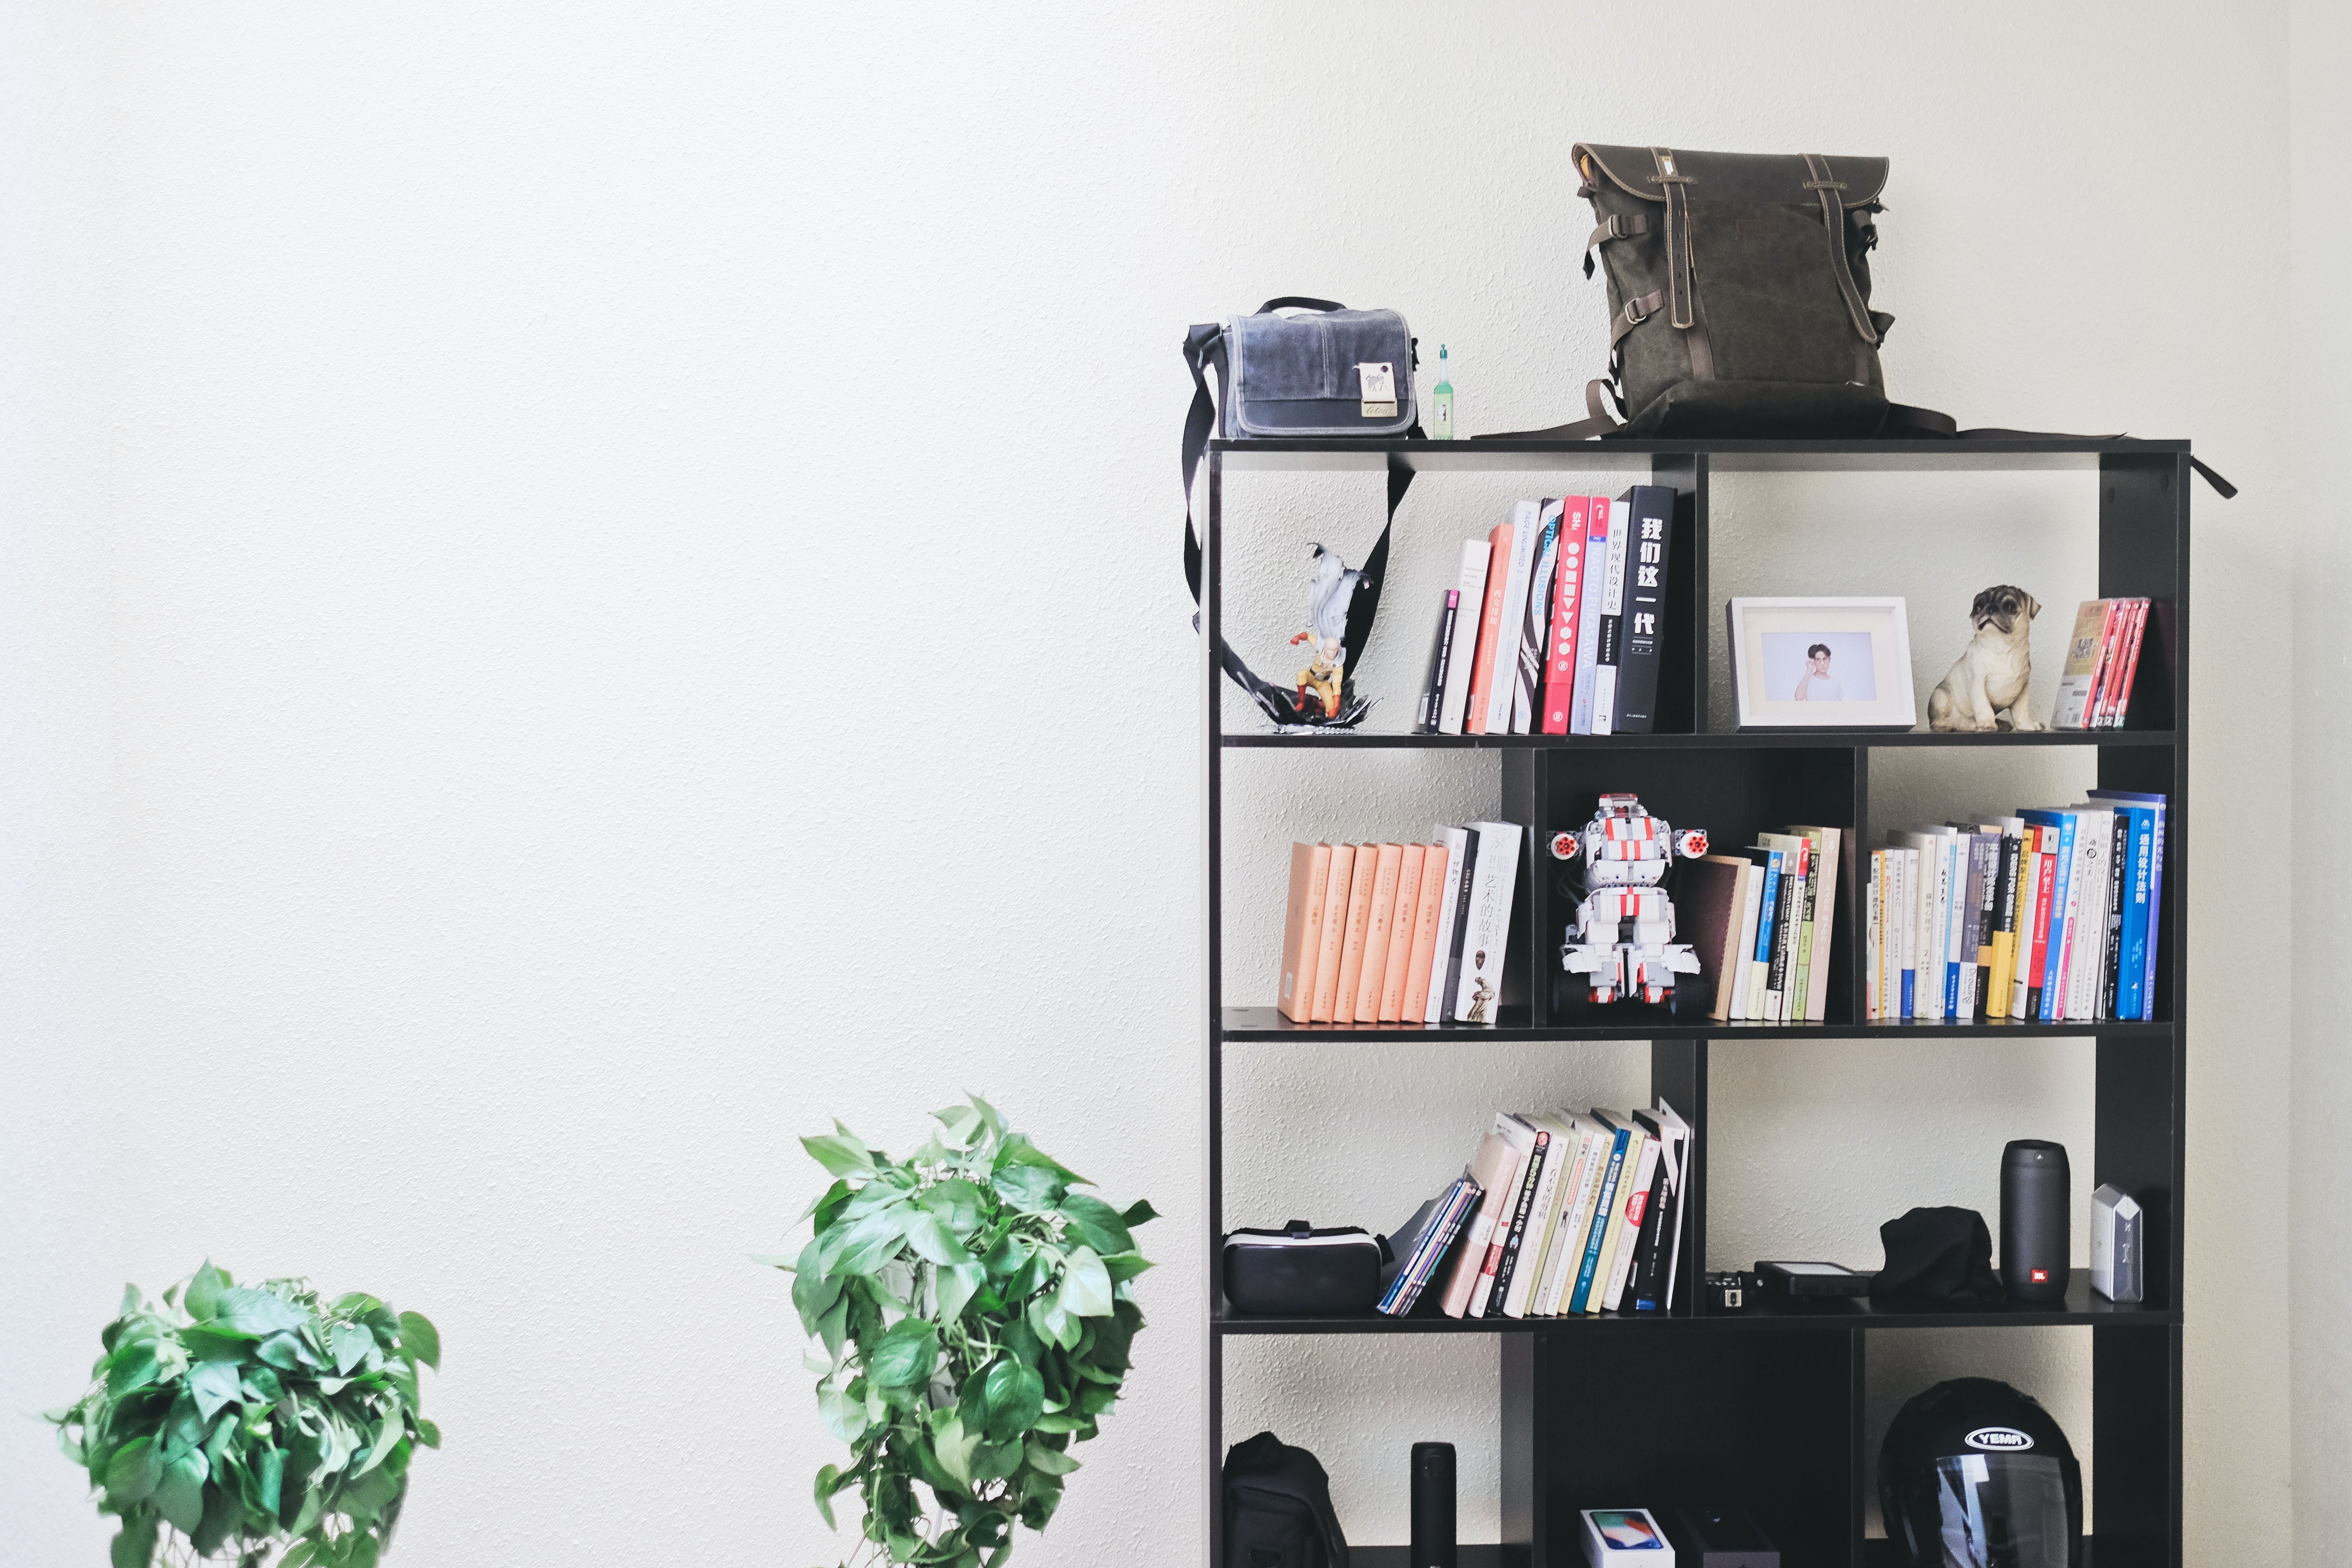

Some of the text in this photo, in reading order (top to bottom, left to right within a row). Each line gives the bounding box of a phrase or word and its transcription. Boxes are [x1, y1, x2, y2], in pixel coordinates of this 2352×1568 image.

[1523, 510, 1532, 529] PAGE
[1534, 514, 1557, 616] OPTICAL ILLUSIONS
[1589, 546, 1602, 593] NAOTO
[1607, 529, 1622, 610] 世界现代设计史
[1633, 517, 1663, 635] 我们这一代
[1583, 596, 1598, 669] FUKASAWA
[2042, 859, 2053, 894] 用户至上
[2135, 833, 2153, 904] 通用设计法则
[1477, 873, 1498, 947] 艺术的故事
